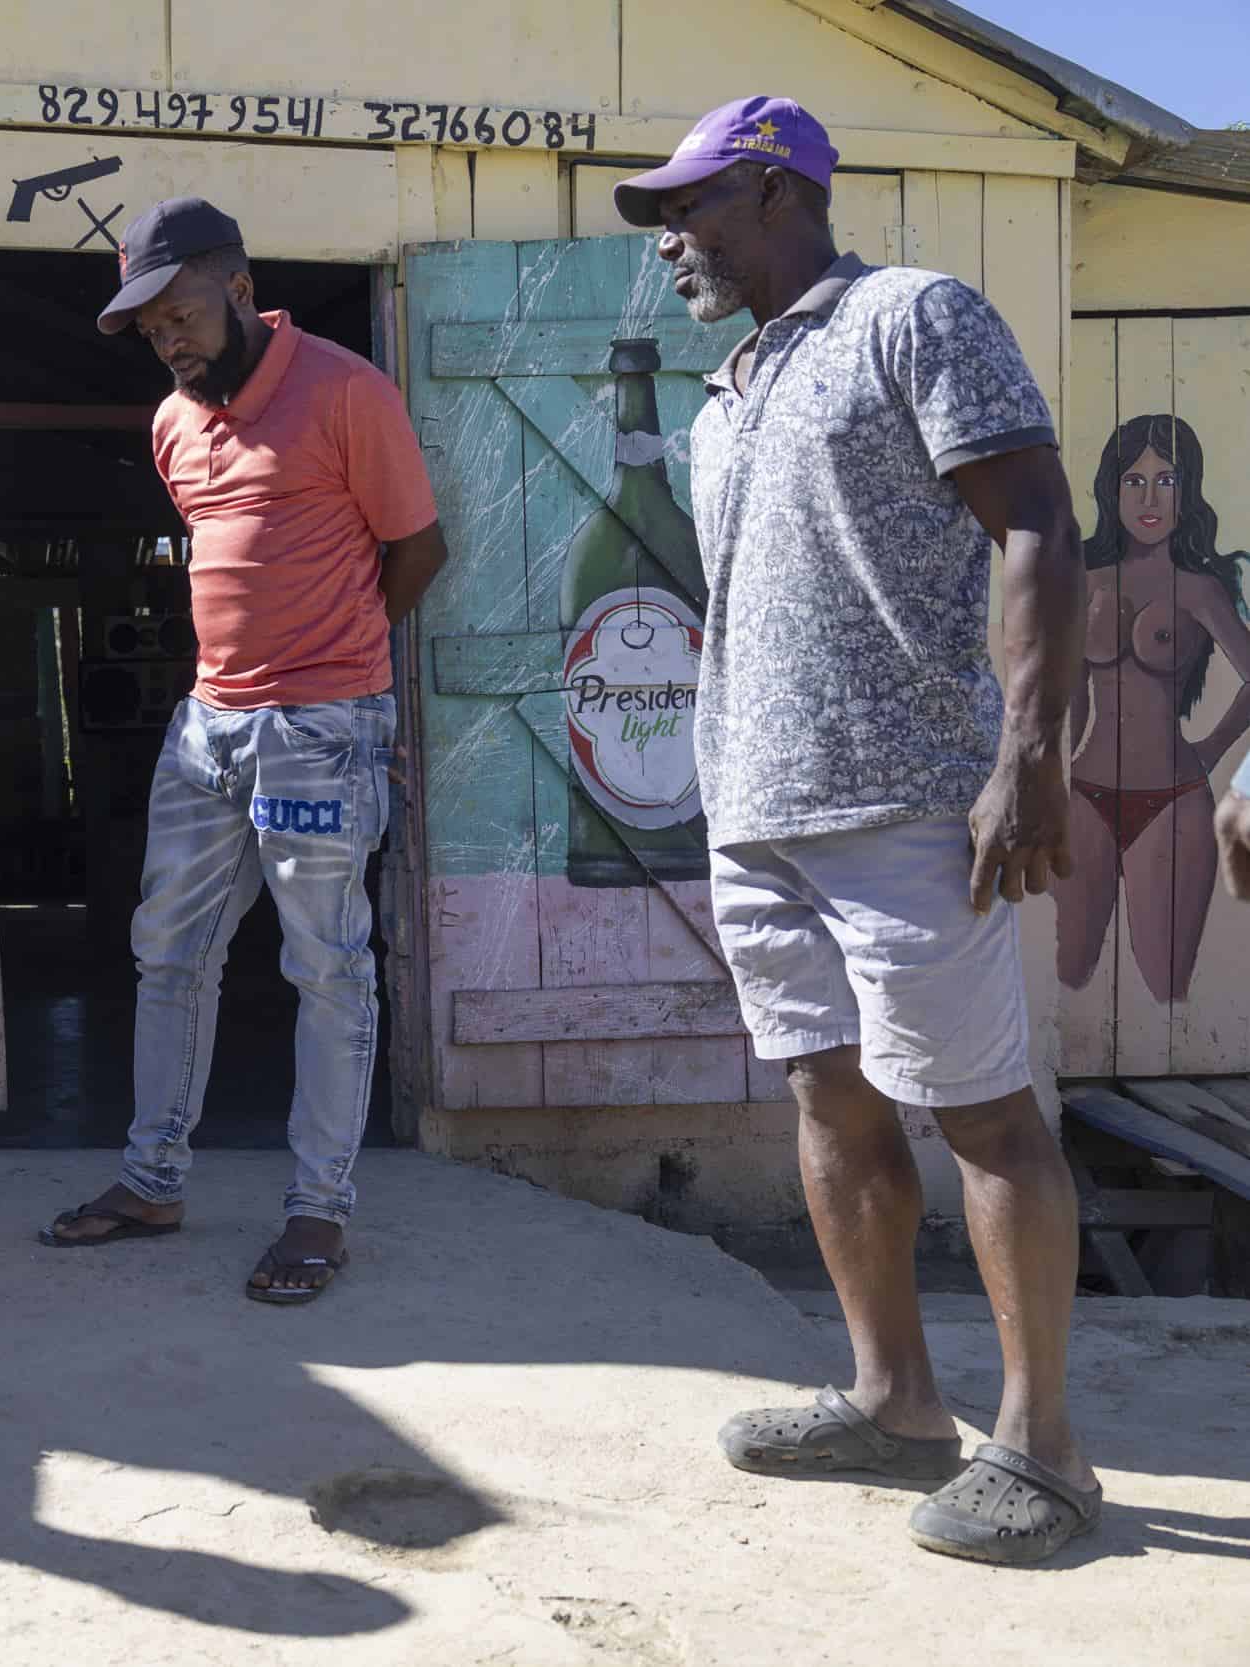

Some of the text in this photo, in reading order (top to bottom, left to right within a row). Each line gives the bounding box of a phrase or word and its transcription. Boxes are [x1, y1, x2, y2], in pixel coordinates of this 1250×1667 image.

[570, 674, 698, 714] Presiden
[620, 711, 686, 752] light
[252, 796, 343, 834] GUCCI
